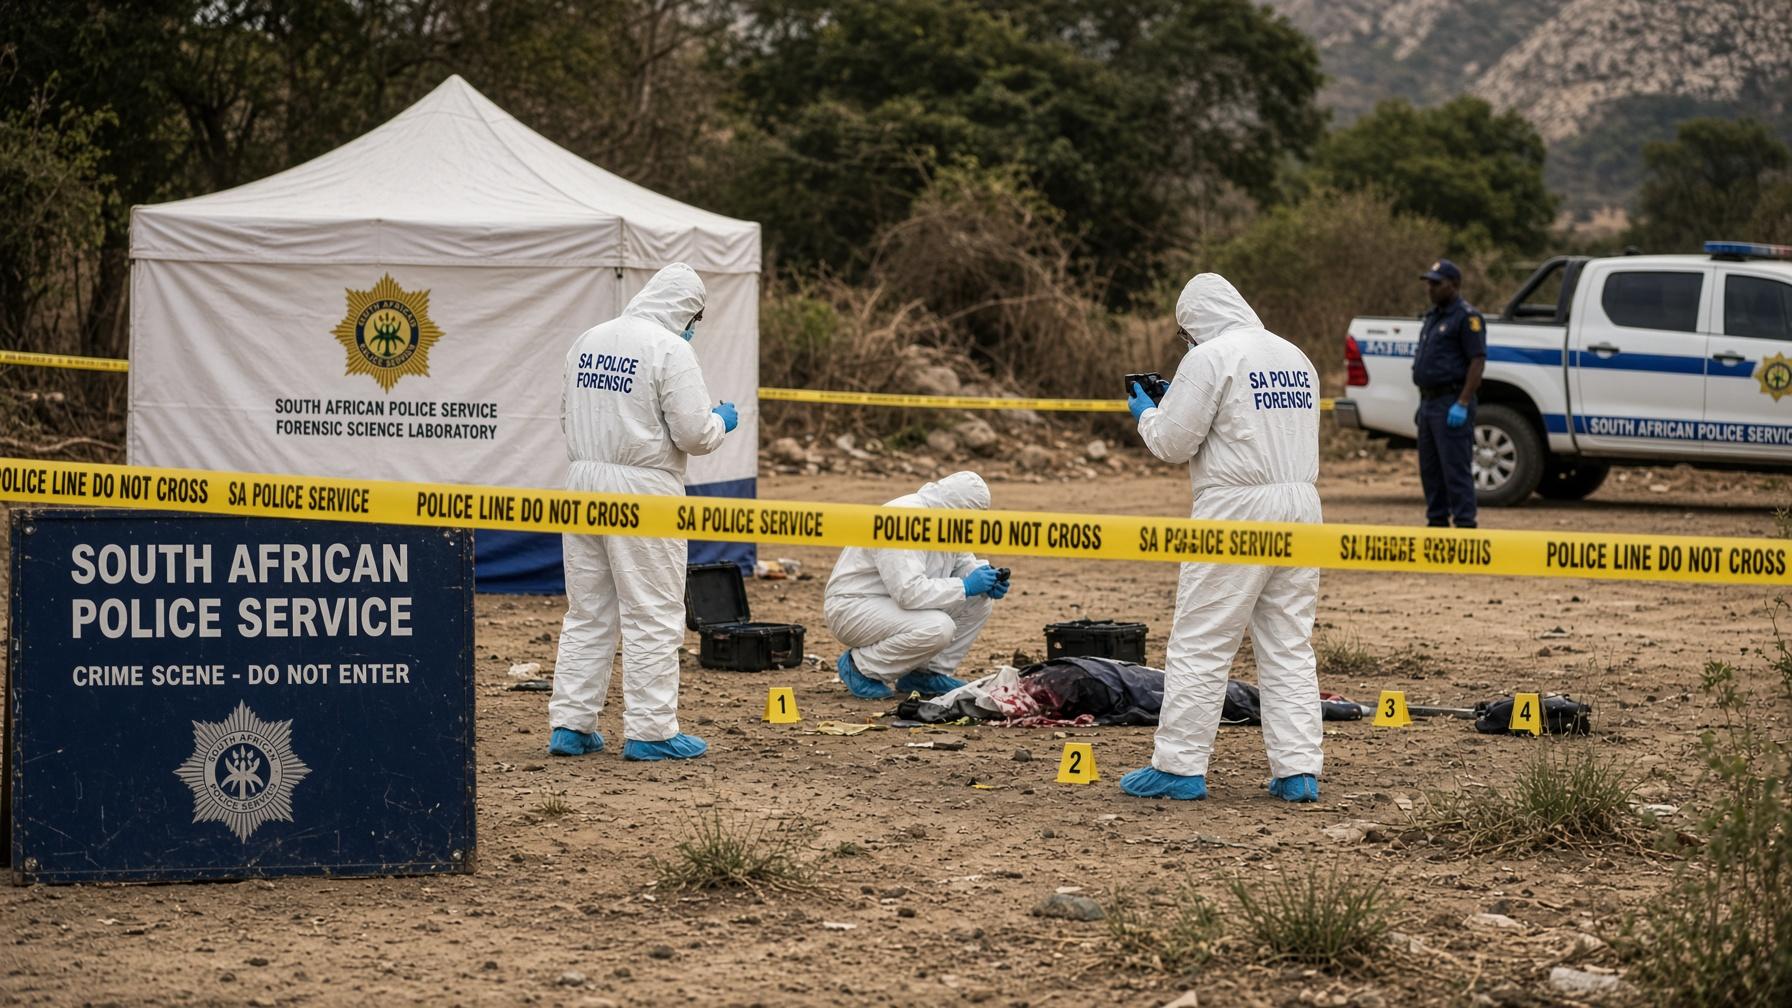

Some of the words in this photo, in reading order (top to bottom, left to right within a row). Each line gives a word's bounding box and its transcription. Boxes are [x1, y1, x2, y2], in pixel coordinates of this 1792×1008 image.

[579, 353, 592, 368] SA
[596, 354, 639, 375] POLICE
[577, 373, 632, 393] FORENSIC
[1249, 372, 1268, 388] SA
[1269, 371, 1310, 388] POLICE
[276, 399, 320, 414] SOUTH
[326, 400, 384, 415] AFRICAN
[390, 402, 436, 416] POLICE
[442, 403, 496, 418] SERVICE
[1254, 391, 1312, 410] FORENSIC
[277, 420, 342, 436] FORENSIC
[348, 422, 403, 437] SCIENCE
[409, 423, 496, 439] LABORATORY
[1590, 417, 1634, 434] SOUTH
[1637, 419, 1694, 439] AFRICAN
[1698, 423, 1744, 442] POLICE
[0, 467, 46, 494] OLICE
[52, 471, 87, 496] LINE
[93, 473, 114, 498] DO
[120, 475, 151, 500] NOT
[157, 477, 208, 503] CROSS
[229, 482, 246, 506] SA
[253, 483, 303, 509] POLICE
[309, 486, 369, 513] SERVICE
[417, 492, 472, 519] POLICE
[480, 496, 514, 521] LINE
[521, 498, 543, 523] DO
[549, 499, 581, 525] NOT
[587, 501, 639, 528] CROSS
[677, 506, 696, 531] SA
[702, 507, 754, 534] POLICE
[760, 510, 823, 537] SERVICE
[874, 515, 931, 542] POLICE
[938, 518, 973, 543] LINE
[980, 520, 1002, 545] DO
[1009, 521, 1041, 547] NOT
[1048, 523, 1101, 550] CROSS
[1140, 527, 1158, 552] SA
[1229, 531, 1292, 557] SERVICE
[72, 544, 211, 584] SOUTH
[228, 543, 407, 583] AFRICAN
[1547, 542, 1606, 569] POLICE
[1614, 544, 1651, 570] LINE
[1659, 546, 1682, 572] DO
[1689, 547, 1722, 573] NOT
[1729, 548, 1785, 575] CROSS
[73, 598, 221, 638] POLICE
[238, 597, 412, 637] SERVICE
[73, 666, 143, 686] CRIME
[152, 665, 224, 685] SCENE
[249, 665, 279, 684] DO
[288, 664, 331, 684] NOT
[340, 664, 409, 683] ENTER
[777, 694, 786, 714] 1
[1385, 698, 1396, 718] 3
[1520, 701, 1531, 721] 4
[208, 735, 236, 762] SOUTH
[1069, 751, 1081, 774] 2
